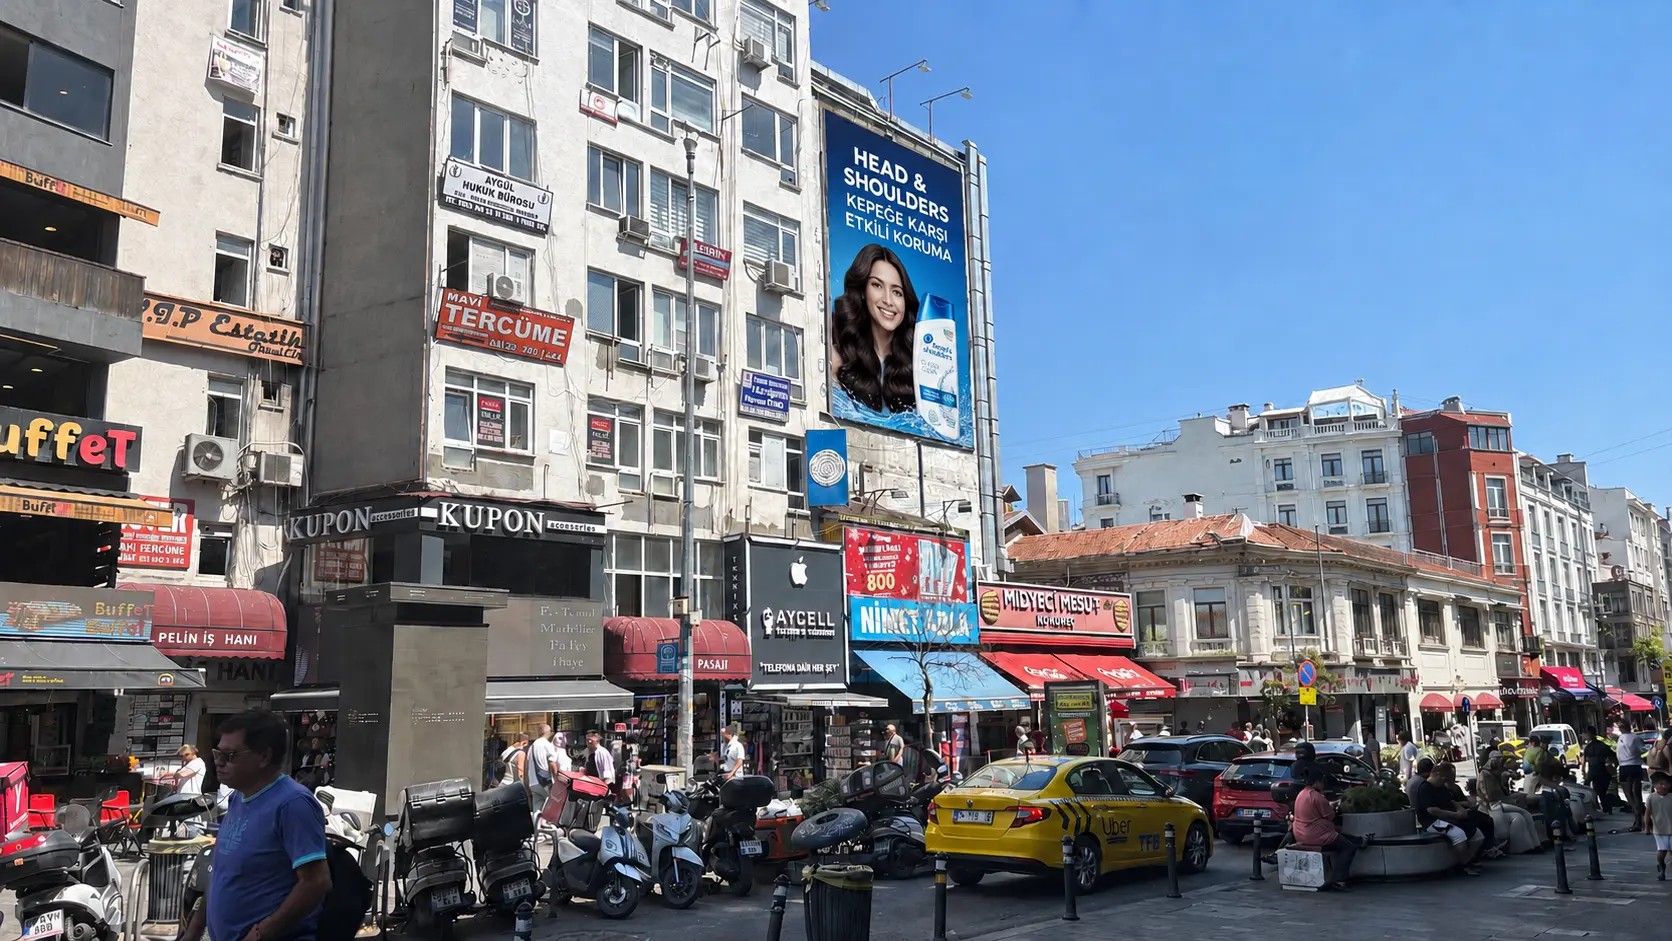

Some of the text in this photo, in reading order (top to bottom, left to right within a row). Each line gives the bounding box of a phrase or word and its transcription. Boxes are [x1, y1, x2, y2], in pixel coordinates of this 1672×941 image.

[485, 176, 515, 192] AYGÜL
[854, 147, 927, 194] HEAD &
[462, 180, 495, 198] HUKUK
[498, 190, 535, 210] BÜROSU
[844, 167, 949, 223] SHOULDERS
[846, 194, 948, 243] KEPEĞE KARŞI
[845, 211, 953, 263] ETKİLİ KORUMA
[447, 292, 483, 308] MAVİ
[445, 303, 568, 347] TERCÜME
[289, 506, 373, 540] KUPON
[439, 502, 545, 534] KUPON
[867, 572, 896, 591] 800
[776, 610, 835, 627] AYCELL
[158, 631, 258, 646] PELİN İŞ HANI
[1101, 816, 1132, 837] Uber
